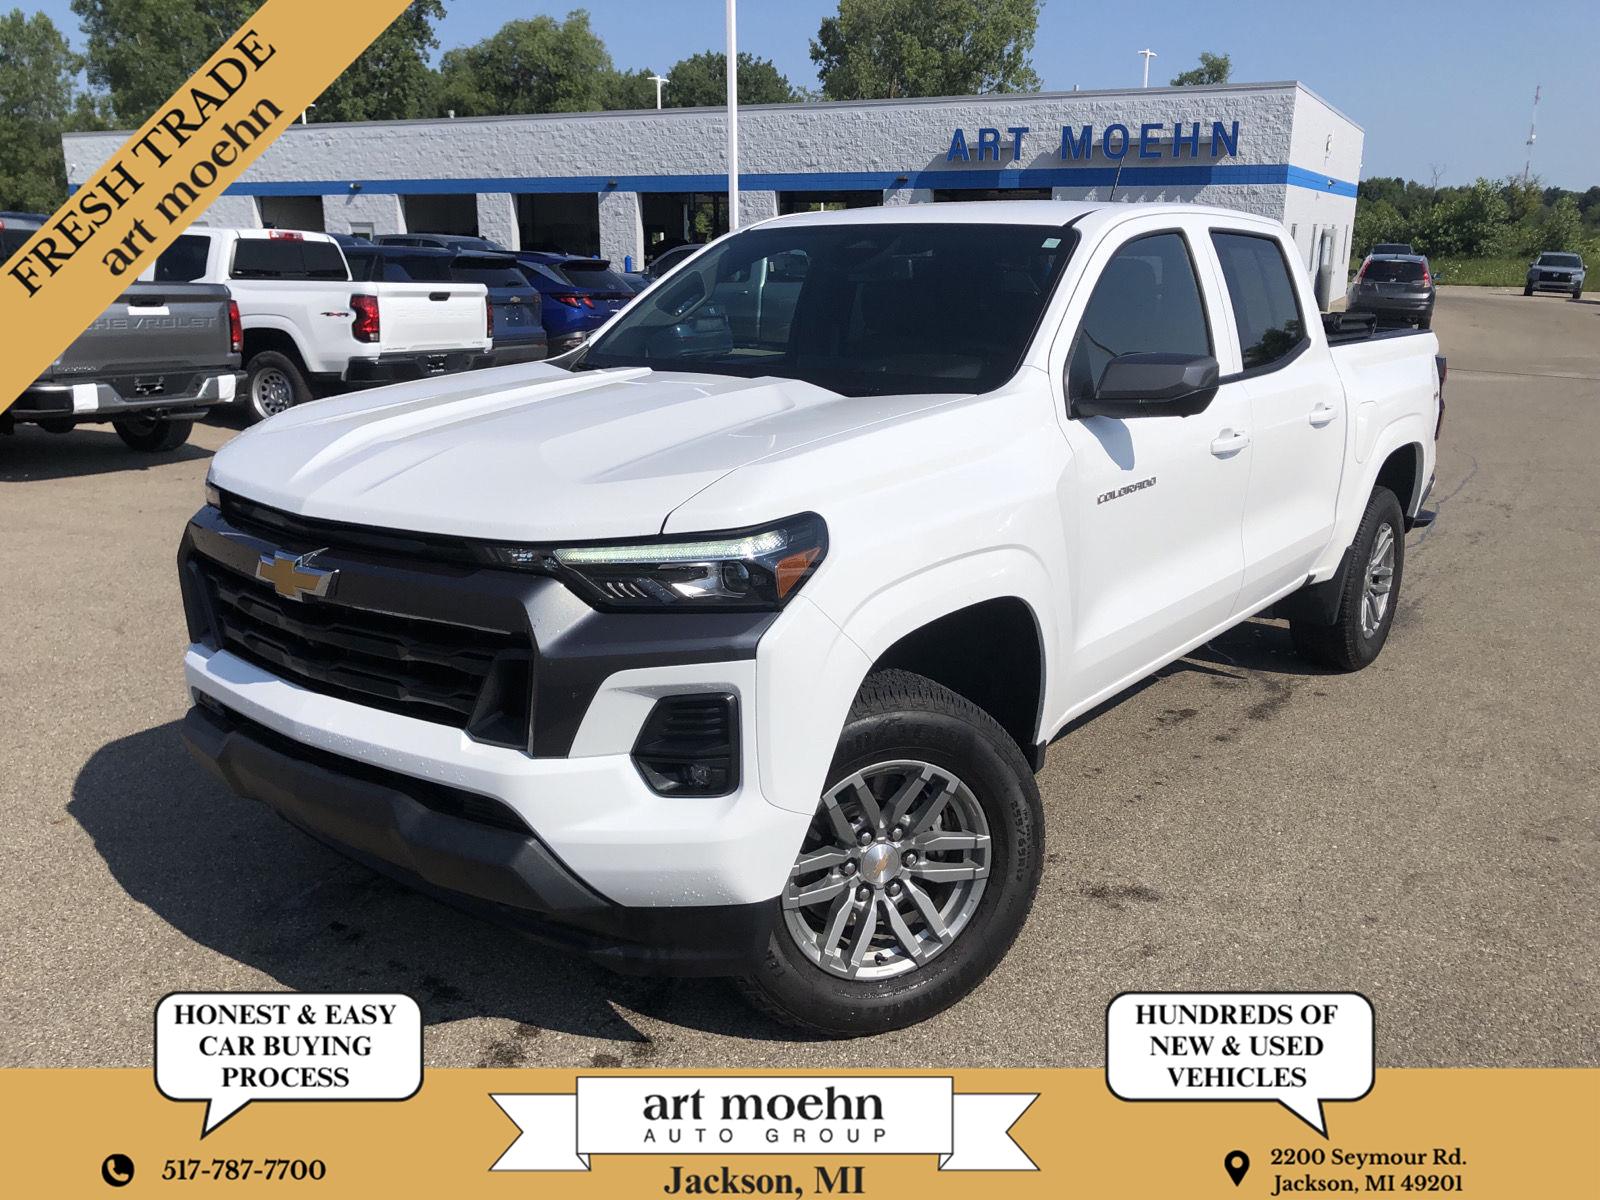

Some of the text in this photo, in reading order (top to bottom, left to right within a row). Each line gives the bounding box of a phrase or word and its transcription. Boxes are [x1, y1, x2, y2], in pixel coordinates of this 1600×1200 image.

[946, 121, 1240, 161] ART MOEHN
[87, 317, 217, 330] HEVROLET
[1097, 477, 1157, 505] COLORADO
